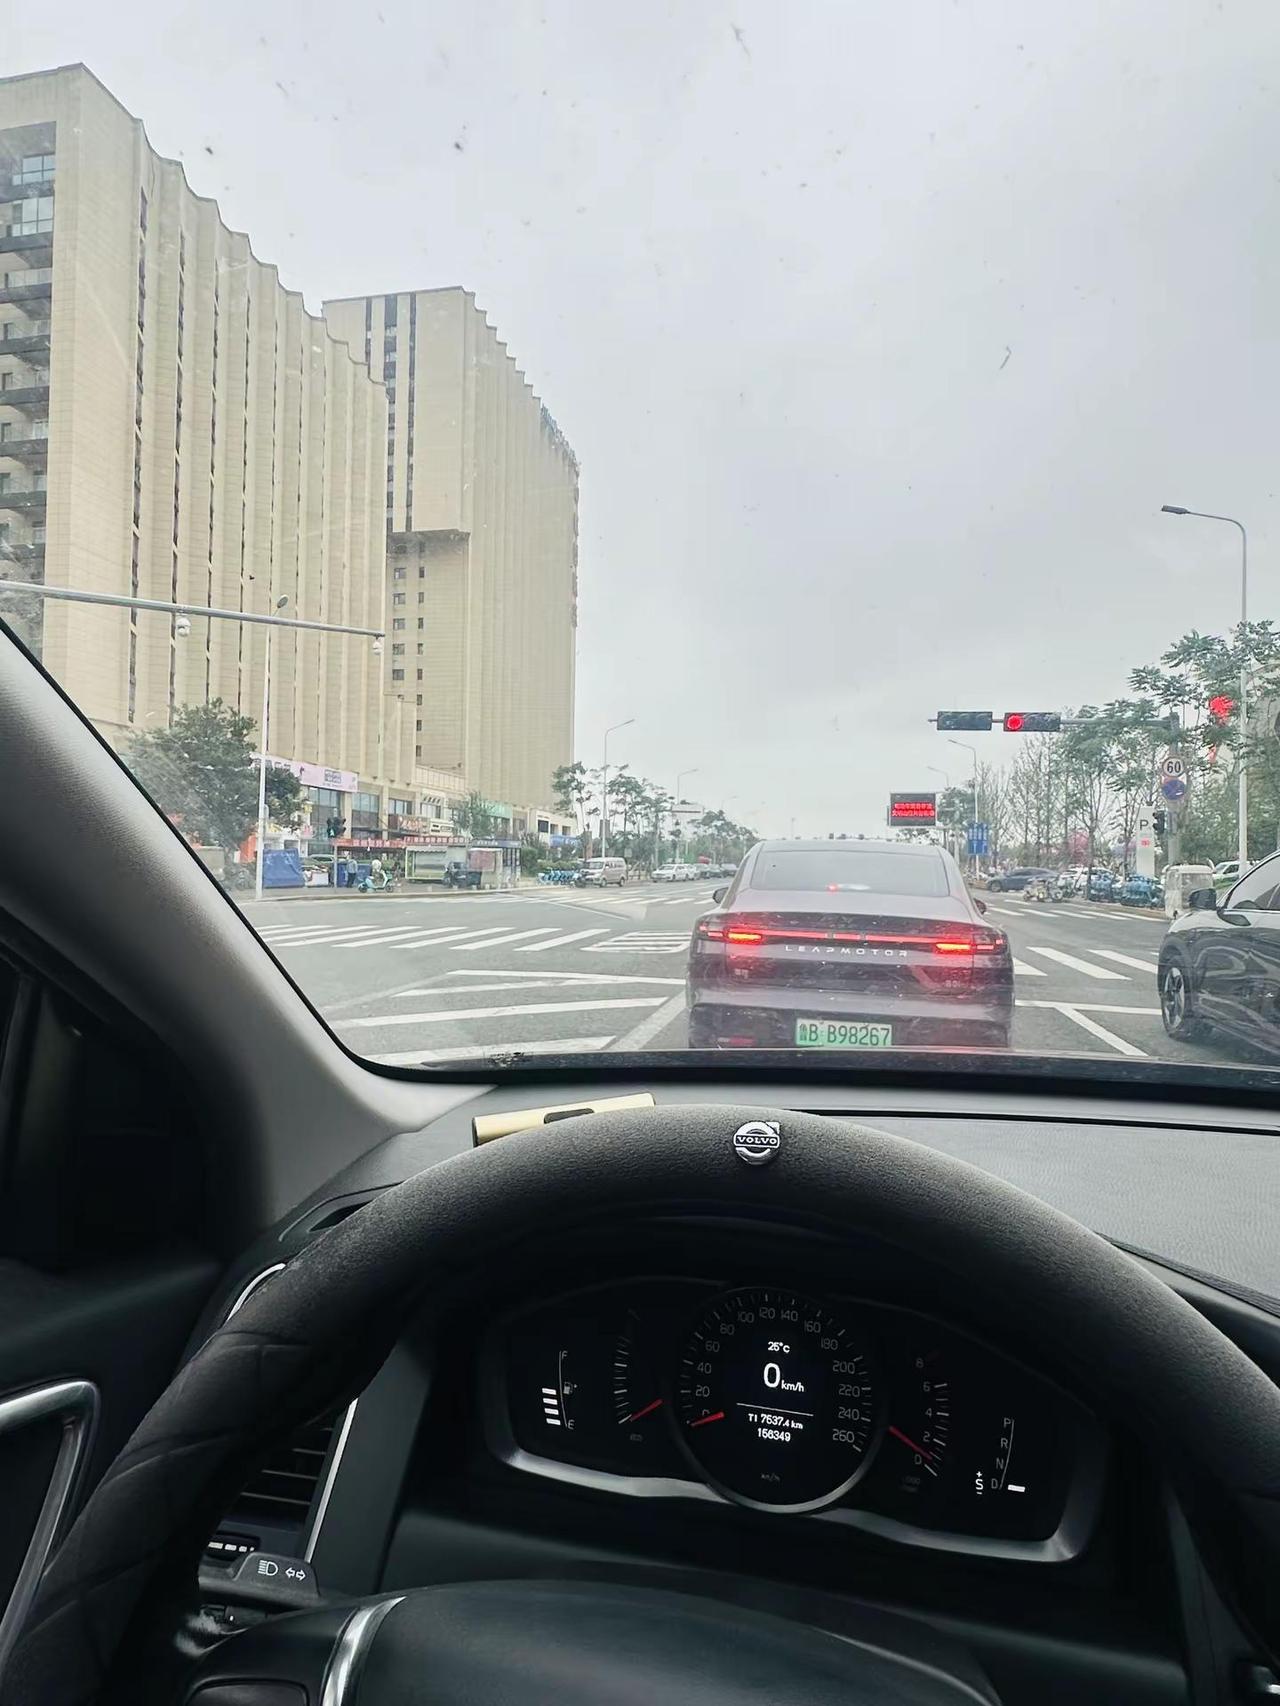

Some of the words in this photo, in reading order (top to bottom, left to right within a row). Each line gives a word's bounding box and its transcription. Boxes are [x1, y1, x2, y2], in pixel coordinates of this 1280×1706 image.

[1166, 761, 1181, 774] 60
[1139, 819, 1149, 831] P
[785, 944, 909, 958] LEAPMOTOR
[827, 1024, 890, 1046] B98267
[737, 1136, 777, 1145] VOLVO
[737, 1311, 755, 1324] 100
[758, 1306, 775, 1320] 120
[780, 1309, 799, 1322] 140
[719, 1323, 736, 1336] 80
[803, 1320, 822, 1334] 160
[705, 1340, 721, 1353] 60
[820, 1337, 839, 1351] 180
[561, 1350, 569, 1360] F
[696, 1362, 712, 1375] 40
[832, 1360, 856, 1375] 200
[763, 1362, 781, 1388] 0
[781, 1379, 805, 1393] km/h
[695, 1384, 711, 1397] 20
[838, 1383, 861, 1398] 220
[923, 1381, 931, 1393] 6
[838, 1406, 860, 1421] 240
[925, 1407, 933, 1418] 4
[567, 1419, 575, 1430] E
[790, 1419, 804, 1430] km
[1003, 1417, 1011, 1428] P
[832, 1428, 855, 1444] 260
[922, 1431, 931, 1442] 2
[1000, 1438, 1008, 1449] R
[996, 1458, 1004, 1470] N
[975, 1478, 984, 1490] S
[991, 1478, 999, 1490] D
